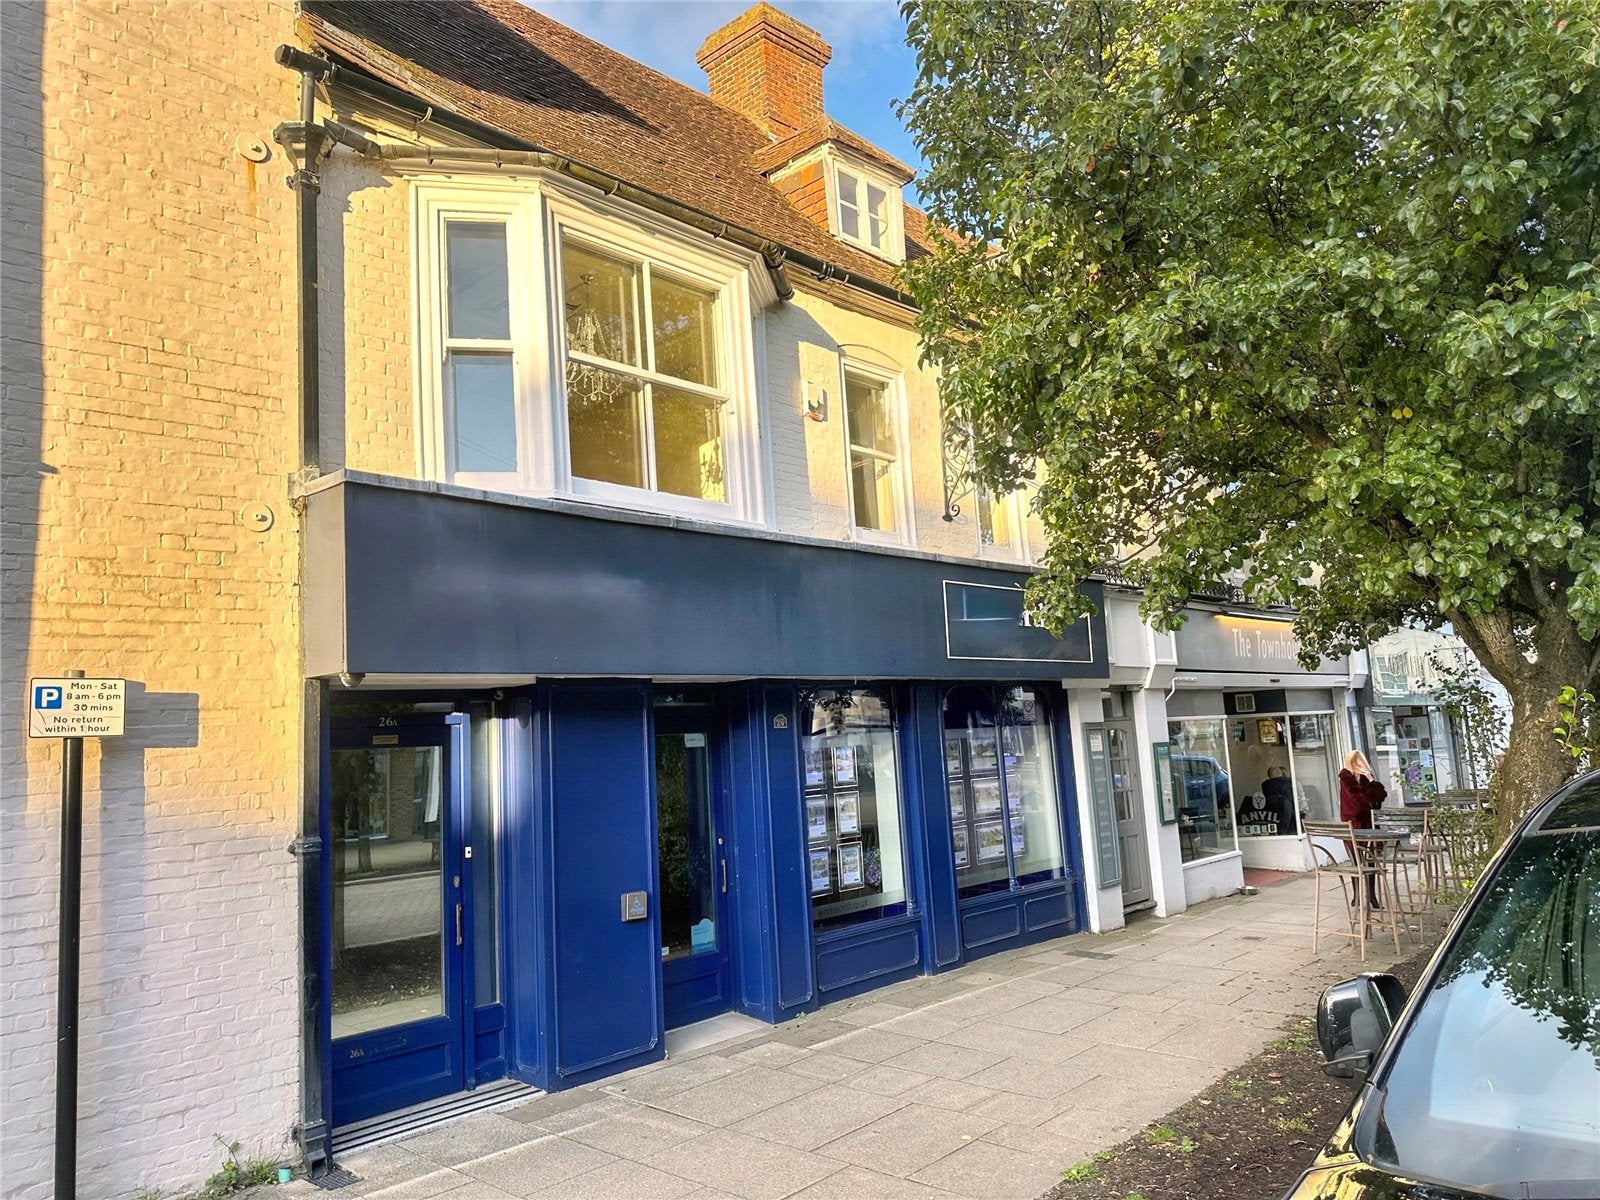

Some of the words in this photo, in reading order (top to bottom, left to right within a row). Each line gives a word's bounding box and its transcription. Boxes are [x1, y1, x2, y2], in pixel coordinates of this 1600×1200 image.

[1232, 627, 1252, 658] The
[1255, 630, 1301, 660] Townhou
[70, 682, 93, 690] Mon
[100, 682, 117, 690] Sat
[41, 688, 59, 707] P
[90, 703, 113, 711] mins
[44, 725, 77, 733] within
